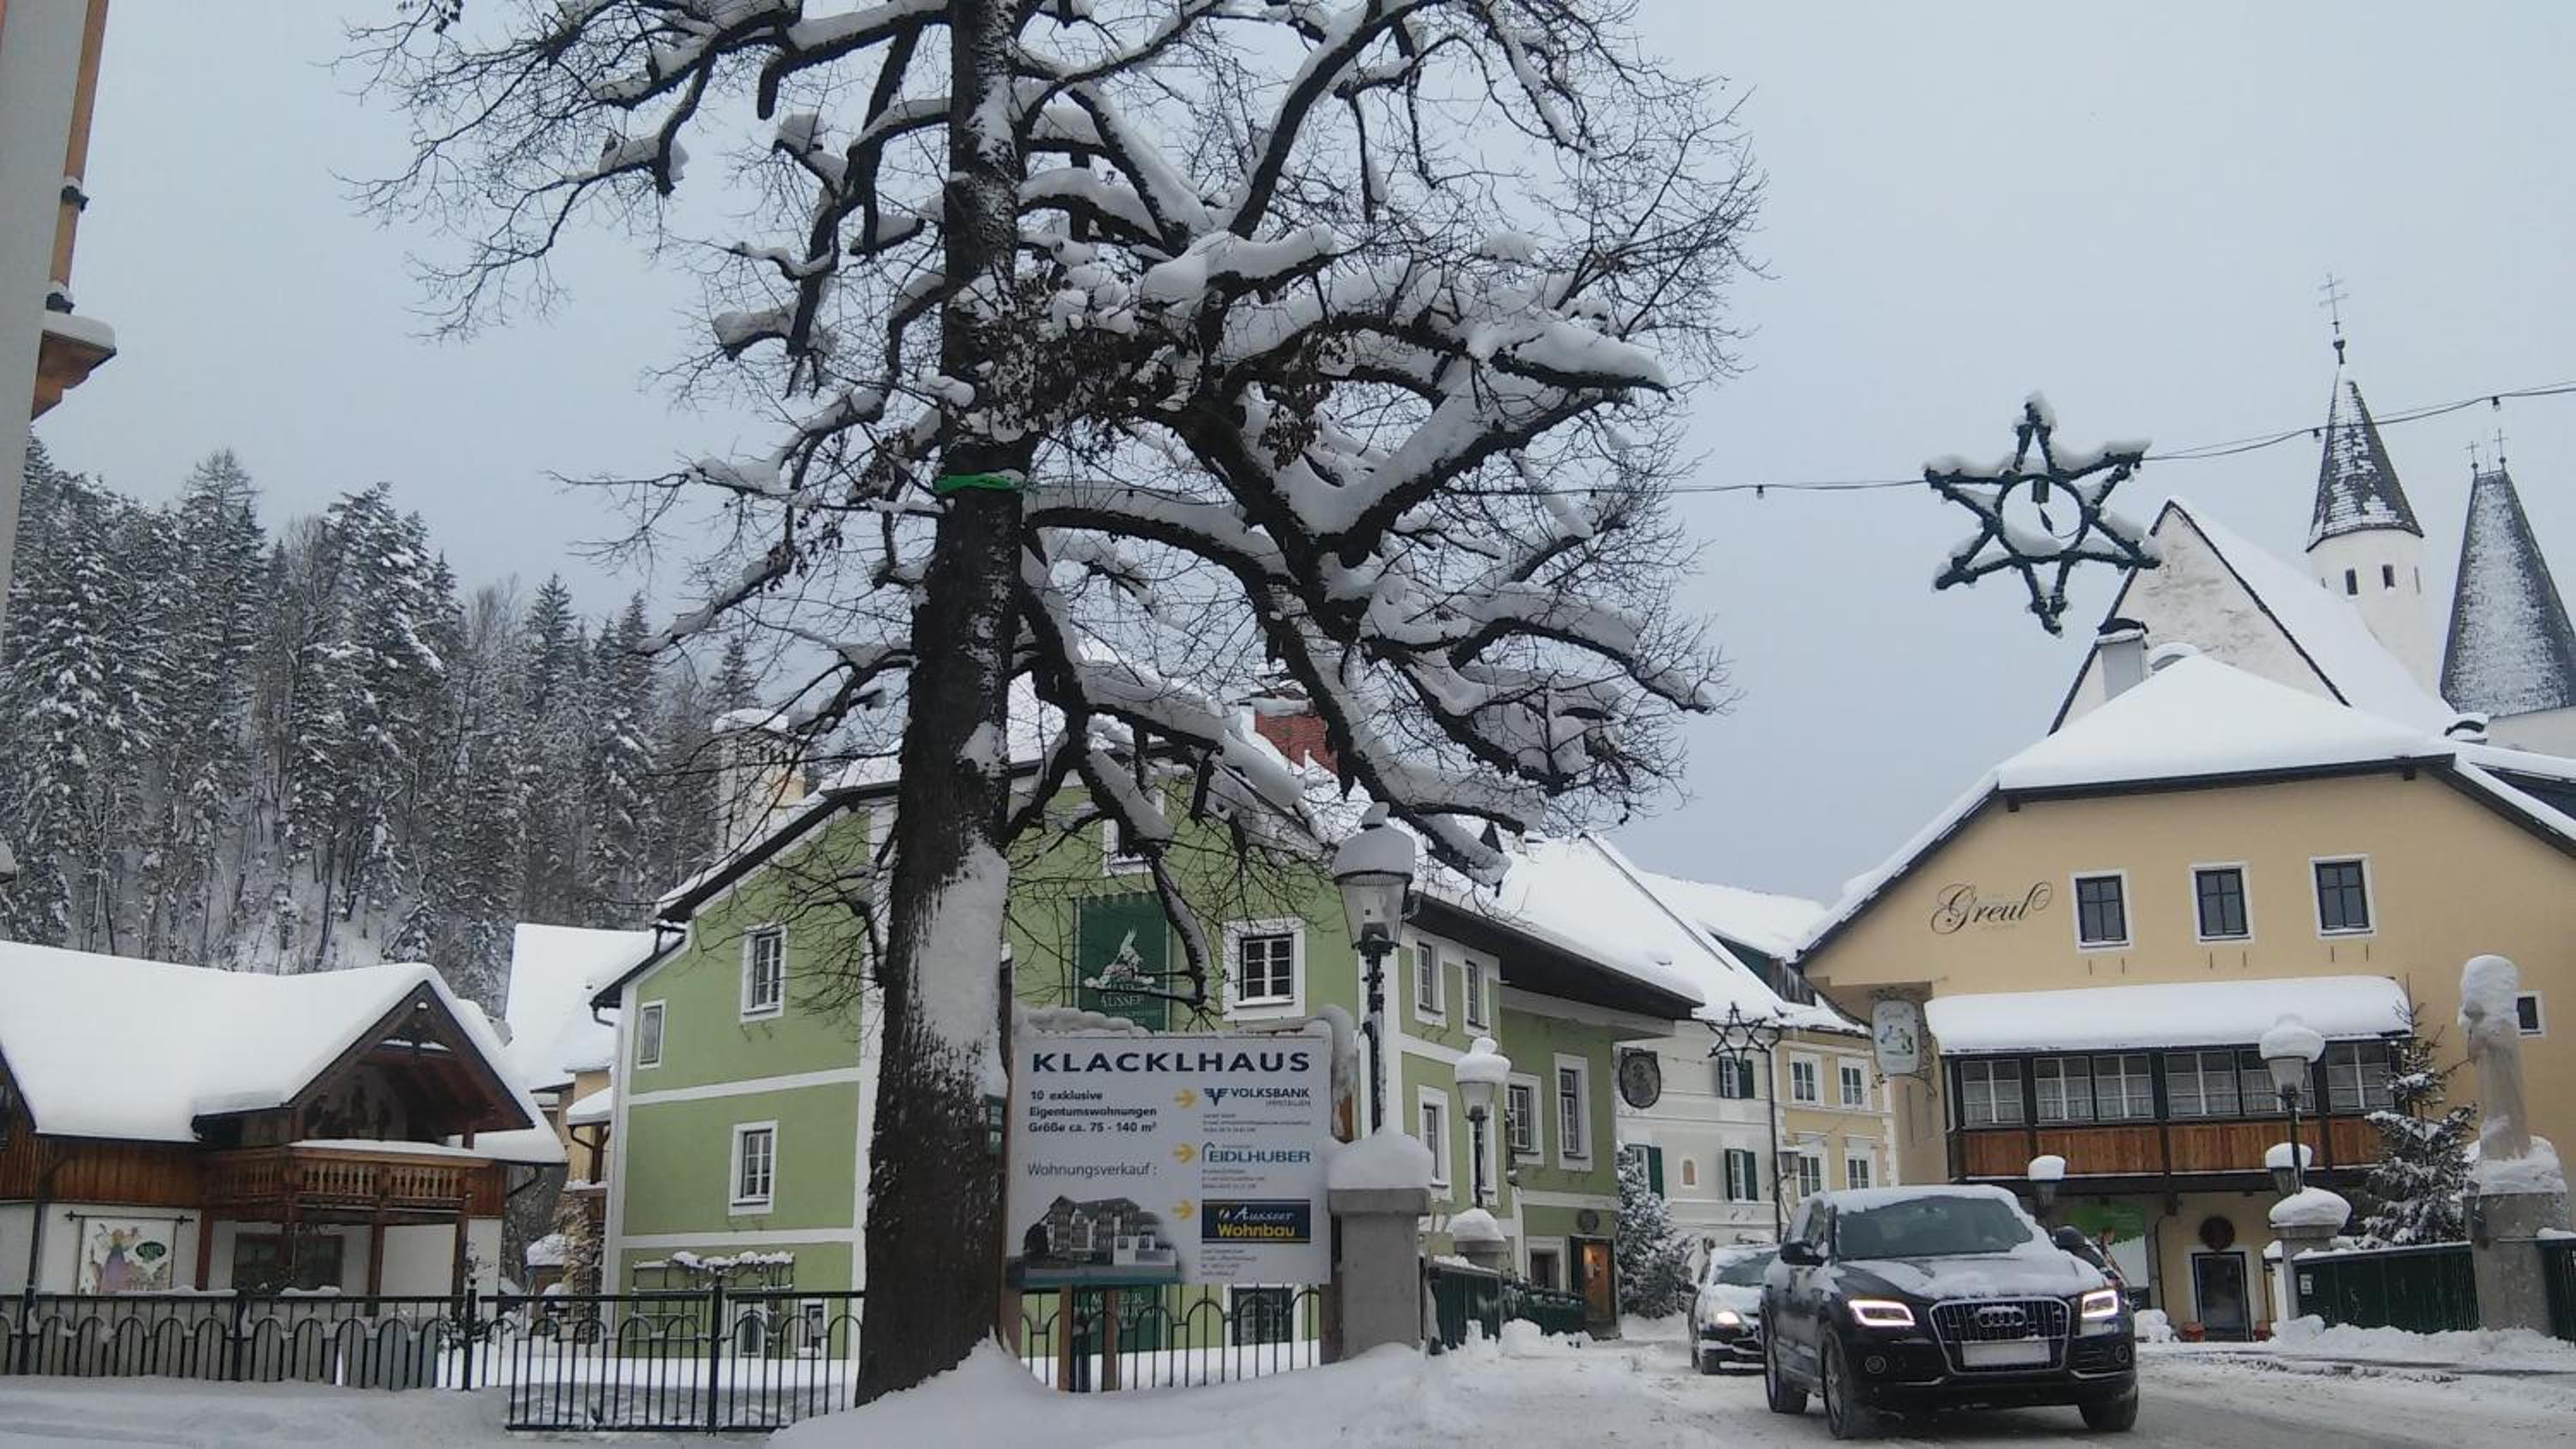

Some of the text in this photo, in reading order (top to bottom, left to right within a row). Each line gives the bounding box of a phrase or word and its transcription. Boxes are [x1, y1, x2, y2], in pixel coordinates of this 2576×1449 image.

[1032, 1052, 1310, 1073] KLACKLHAUS
[1030, 1089, 1103, 1100] 10 exklusive
[1230, 1087, 1309, 1099] VOLKSBANK
[1030, 1106, 1157, 1119] Eigentumswohnungen
[1028, 1121, 1066, 1132] Größe
[1068, 1124, 1086, 1132] ca.
[1090, 1121, 1104, 1132] 75
[1116, 1121, 1138, 1132] 140
[1217, 1222, 1296, 1237] Wohnbau
